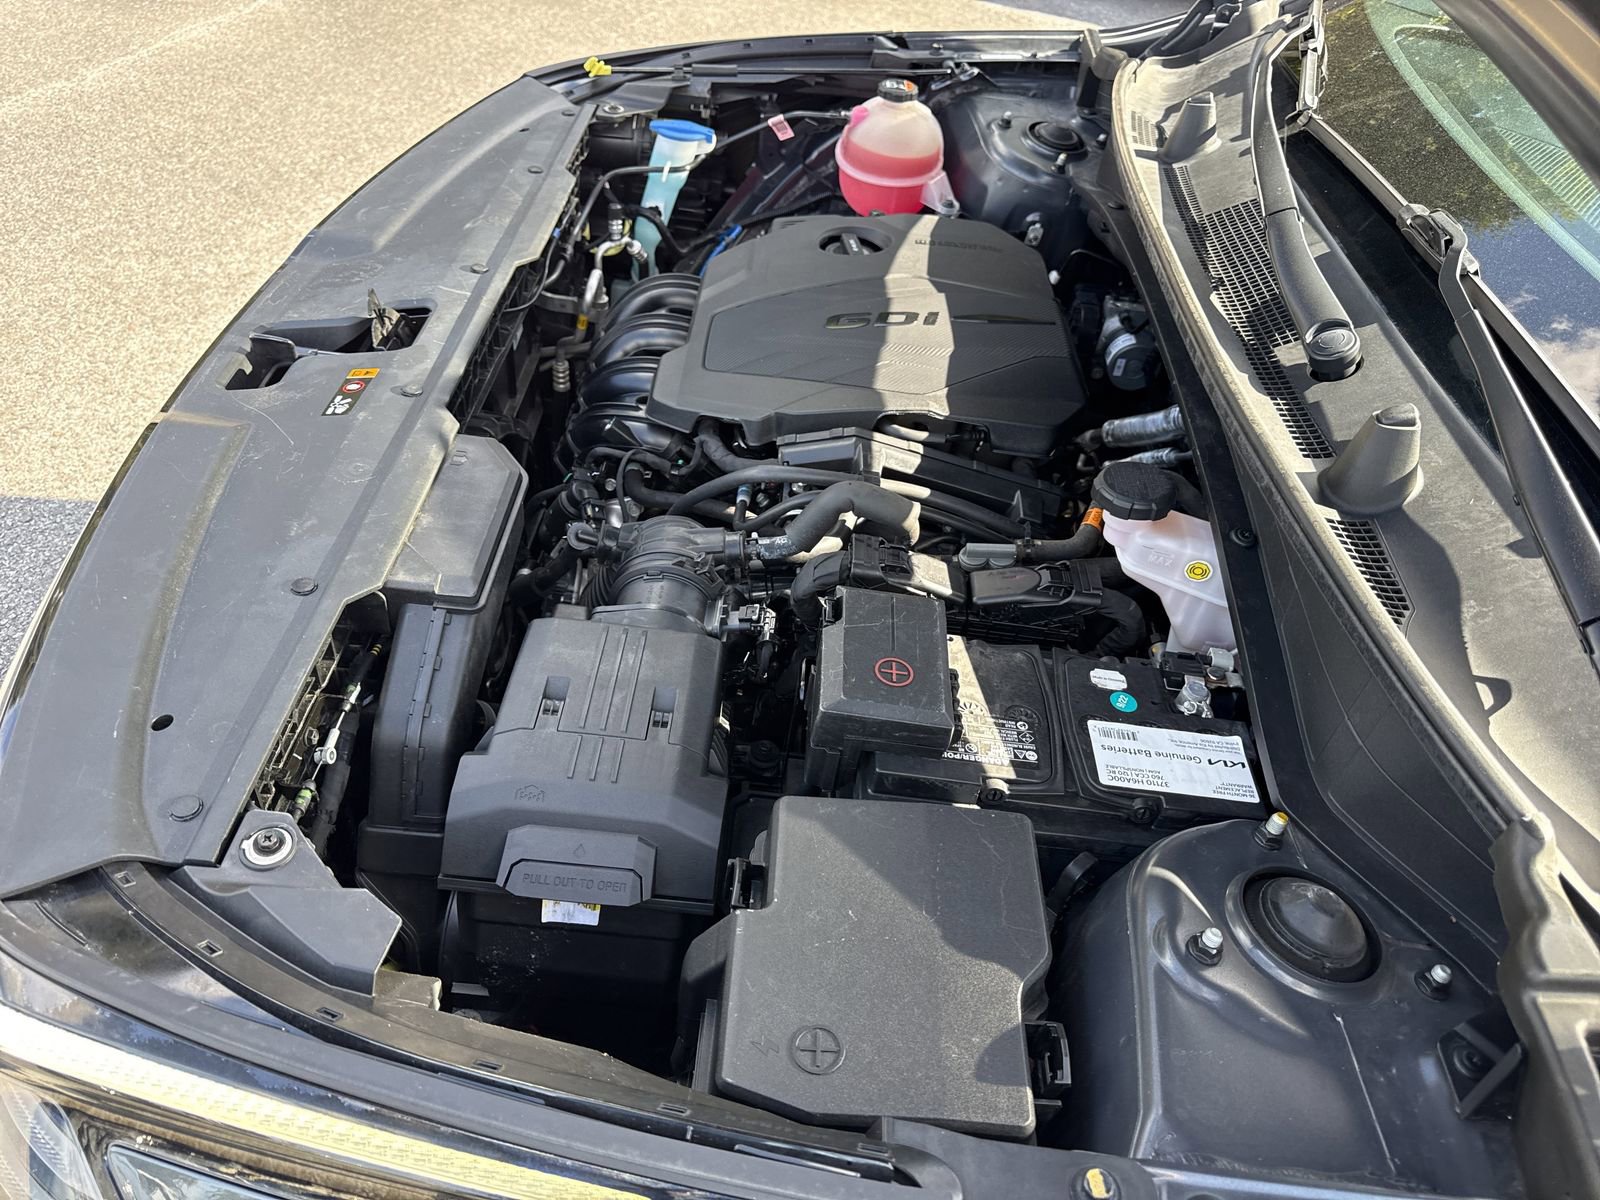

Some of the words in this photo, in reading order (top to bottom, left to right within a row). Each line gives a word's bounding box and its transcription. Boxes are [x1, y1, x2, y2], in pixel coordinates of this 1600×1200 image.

[824, 311, 940, 329] GDI
[1100, 744, 1151, 758] Batteries
[1155, 751, 1202, 764] Genuine
[1207, 758, 1246, 769] KIA
[1134, 771, 1150, 779] CCA
[1146, 779, 1170, 788] 37110
[523, 873, 551, 886] PULL
[553, 876, 576, 888] OUT
[580, 878, 594, 889] TO
[597, 880, 628, 893] OPEN
